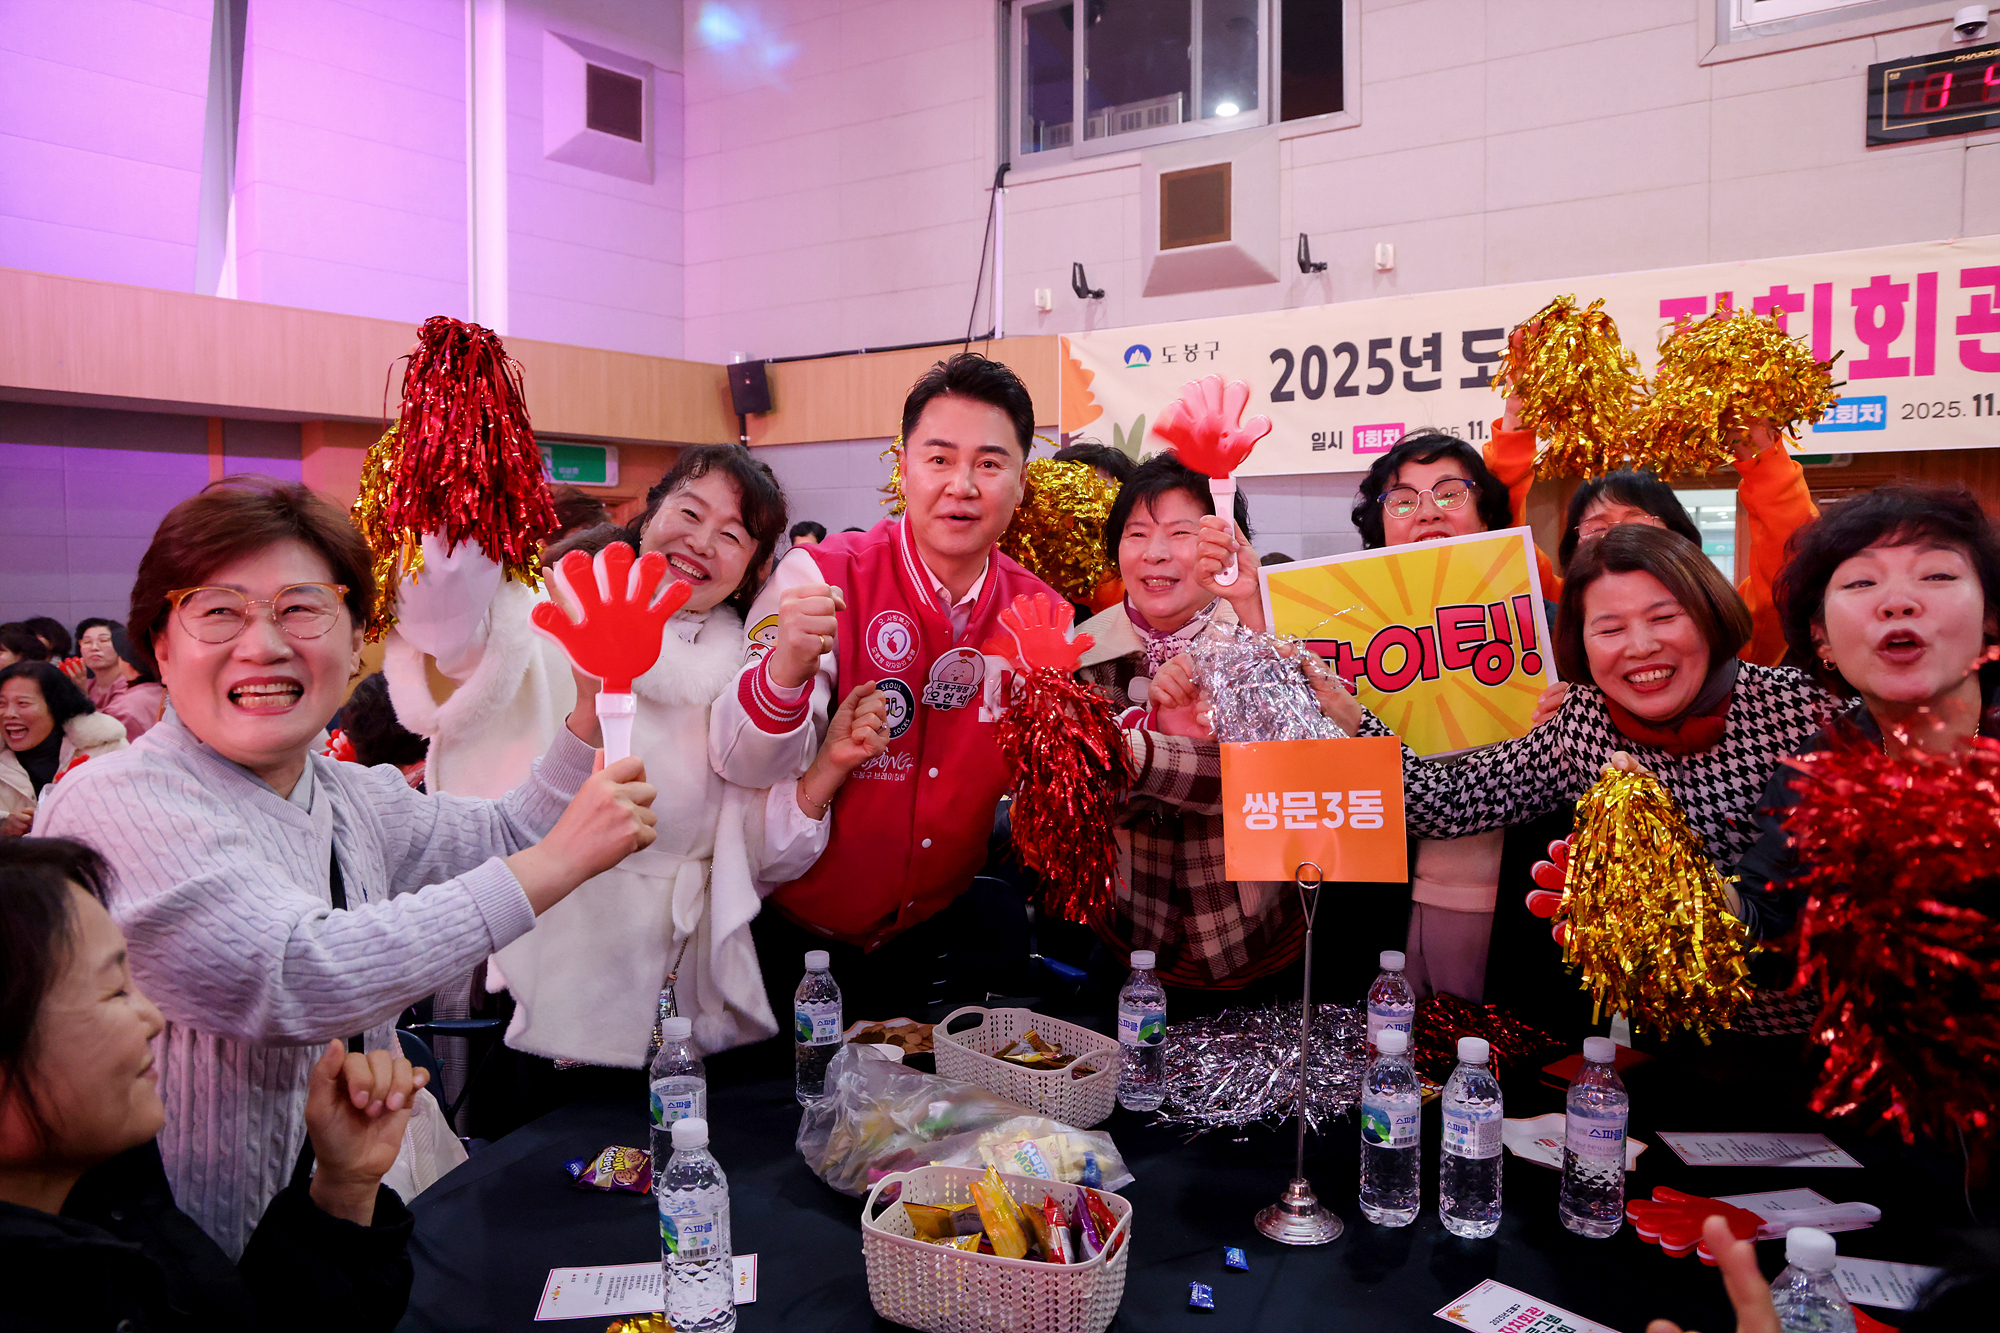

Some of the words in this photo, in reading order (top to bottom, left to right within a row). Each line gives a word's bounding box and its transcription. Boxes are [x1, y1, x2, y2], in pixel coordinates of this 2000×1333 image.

[1162, 341, 1220, 364] 도봉구
[1269, 332, 1442, 403] 2025년
[1817, 403, 1884, 425] 2회차
[1901, 401, 1966, 420] 2025.
[1311, 431, 1343, 451] 일시
[1356, 428, 1401, 448] 1회차
[880, 682, 902, 692] SEOUL
[935, 683, 970, 694] 도봉구청장
[893, 718, 910, 736] SOCKS
[851, 770, 873, 780] 도봉구
[1242, 789, 1384, 830] 쌍문3동
[667, 1100, 692, 1109] 스파클
[1588, 1128, 1623, 1142] 스파클
[601, 1146, 620, 1174] Happy
[1021, 1142, 1051, 1180] Happ
[683, 1222, 713, 1234] 스파클
